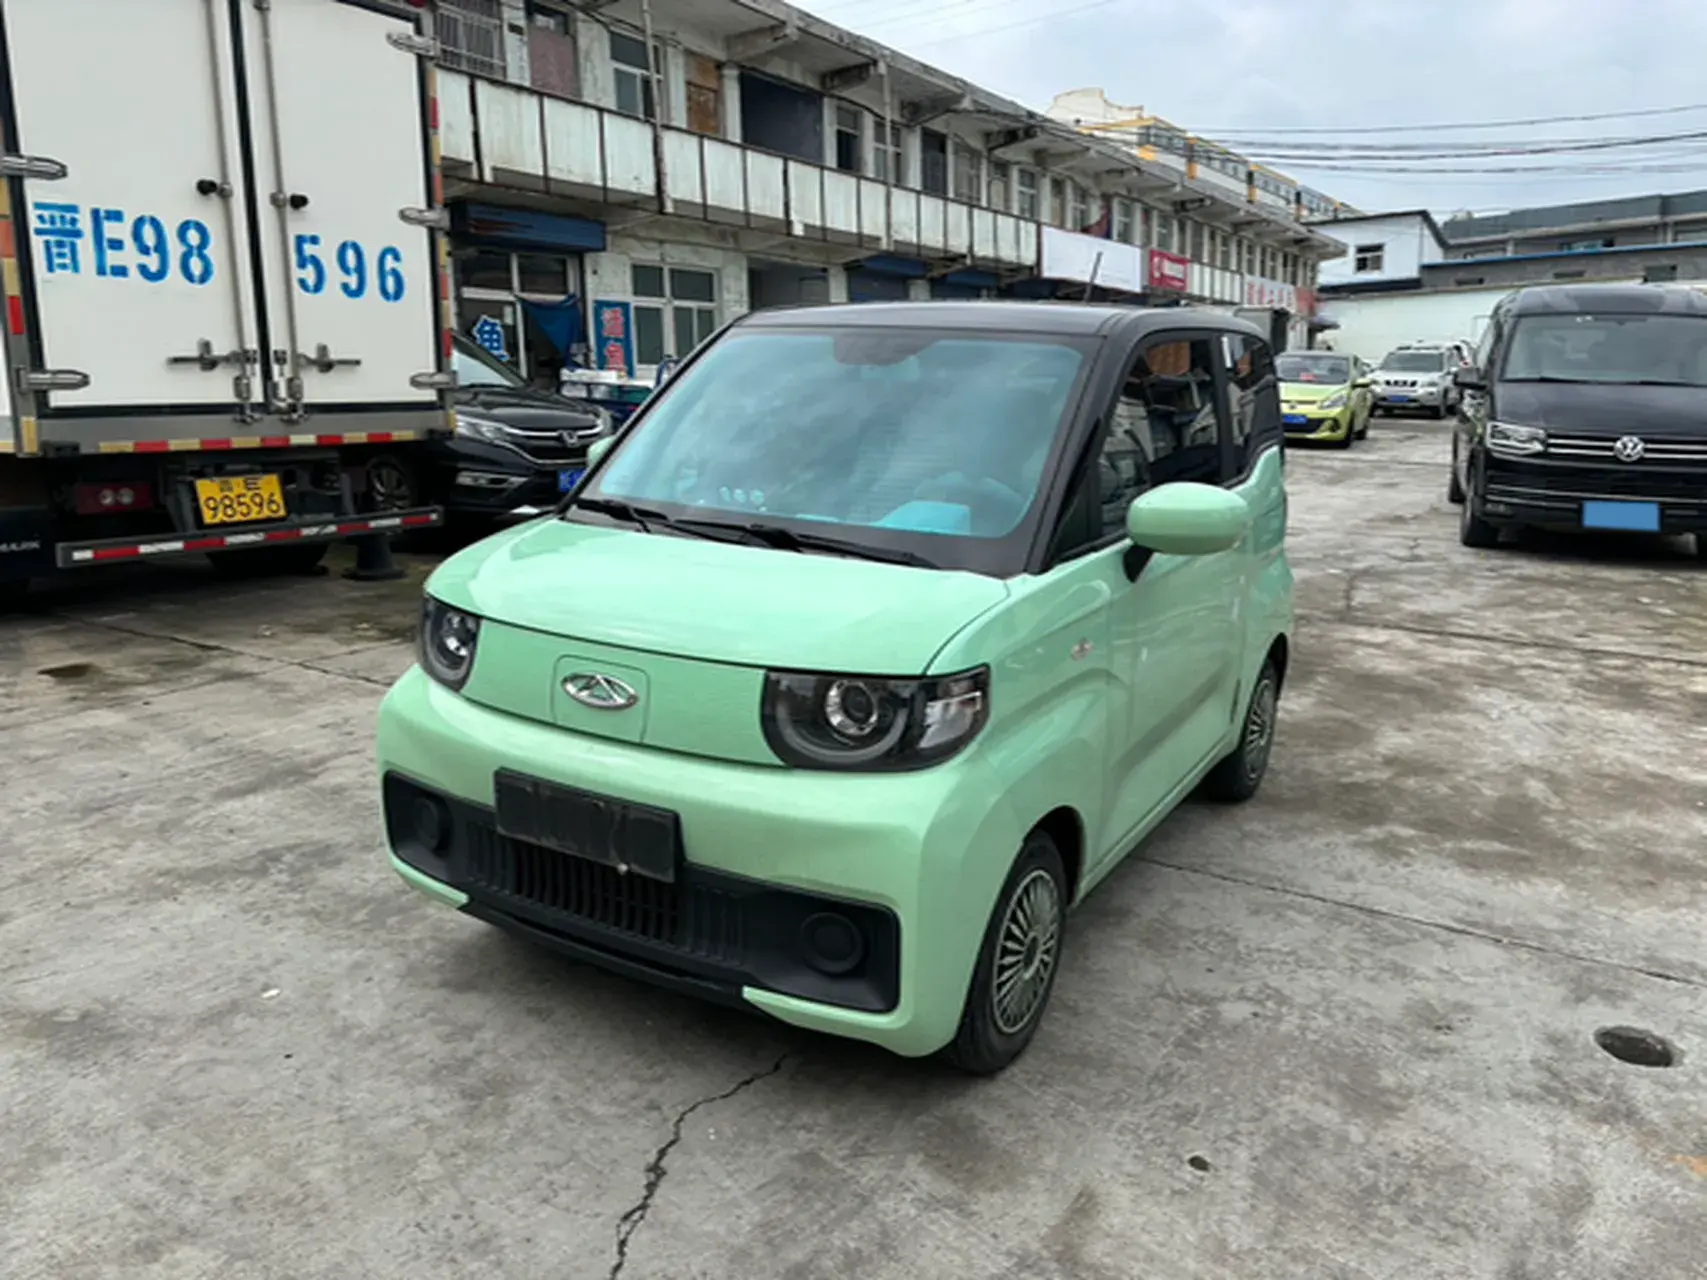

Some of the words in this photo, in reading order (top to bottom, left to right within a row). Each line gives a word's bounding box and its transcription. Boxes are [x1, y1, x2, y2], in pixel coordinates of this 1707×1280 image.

[33, 201, 215, 286] 晋E98
[293, 233, 406, 303] 596
[203, 491, 281, 520] 98596
